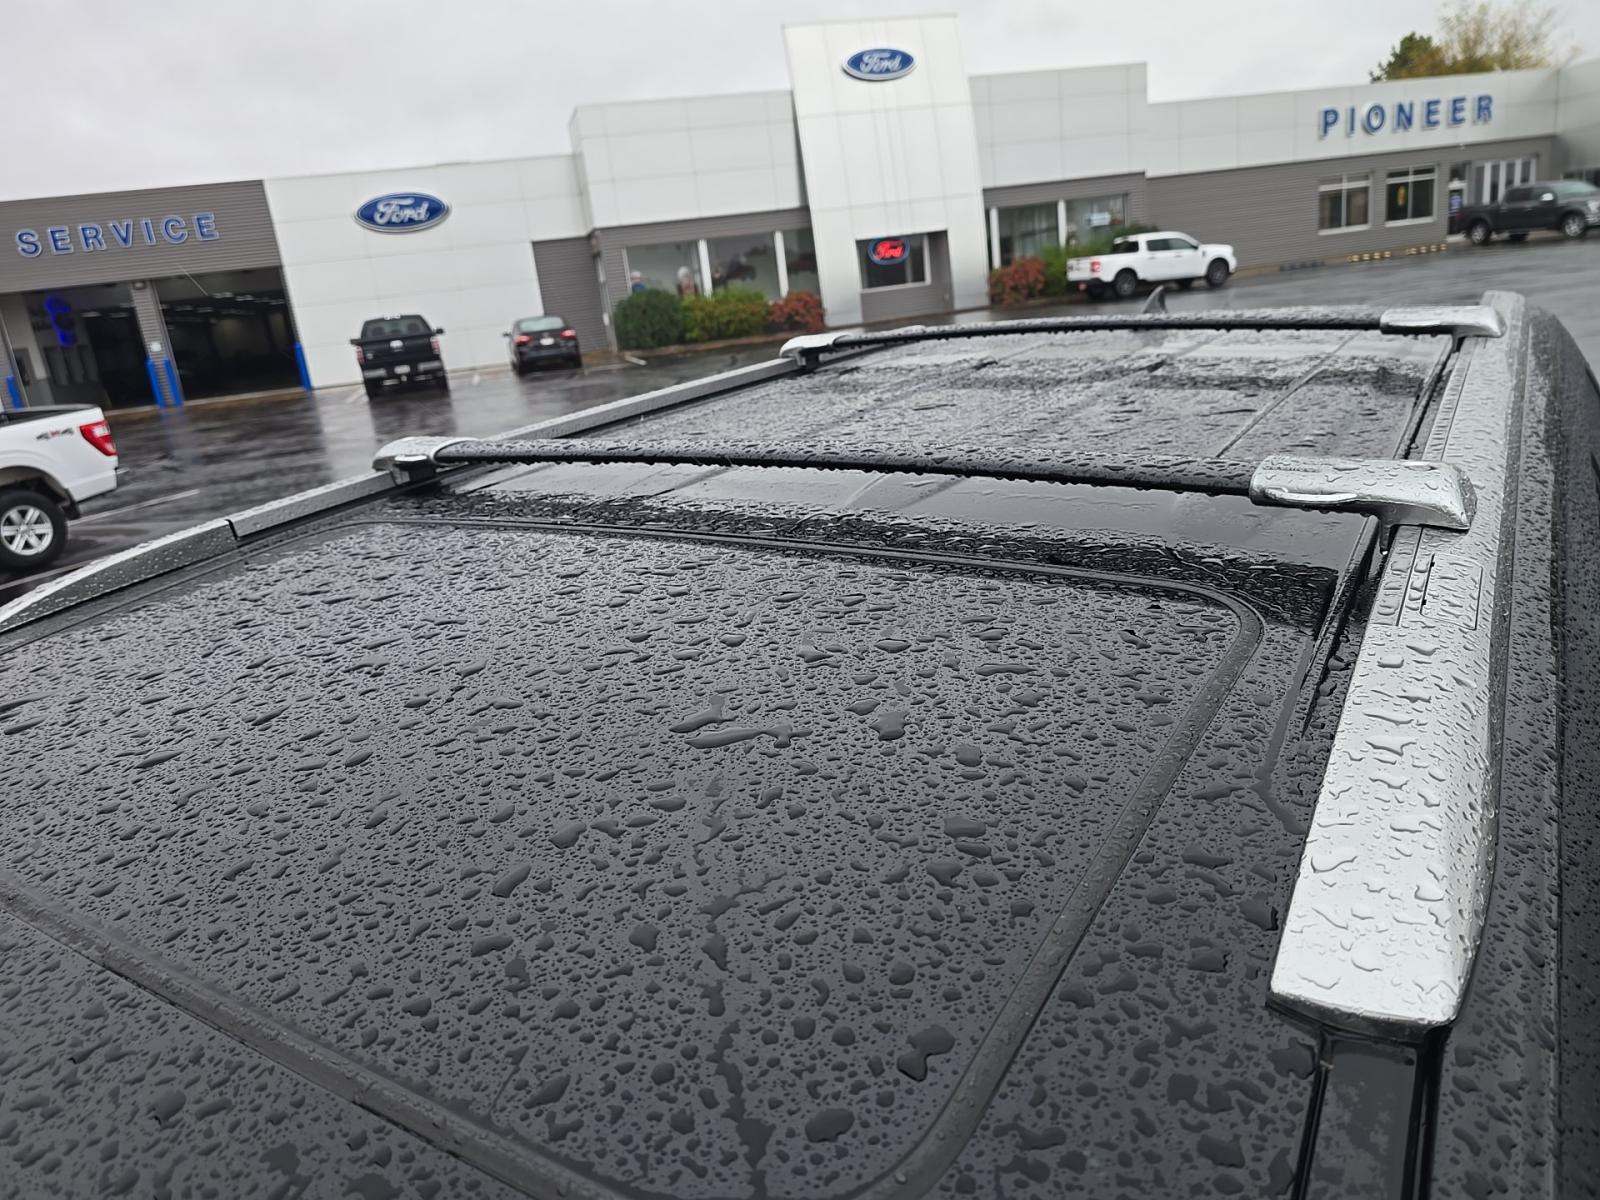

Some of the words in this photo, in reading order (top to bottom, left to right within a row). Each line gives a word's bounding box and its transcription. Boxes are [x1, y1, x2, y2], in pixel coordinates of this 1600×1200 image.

[860, 52, 903, 74] Ford
[1320, 93, 1494, 138] PIONEER
[371, 196, 430, 225] Ford
[15, 211, 220, 257] SERVICE
[874, 239, 905, 259] Ford
